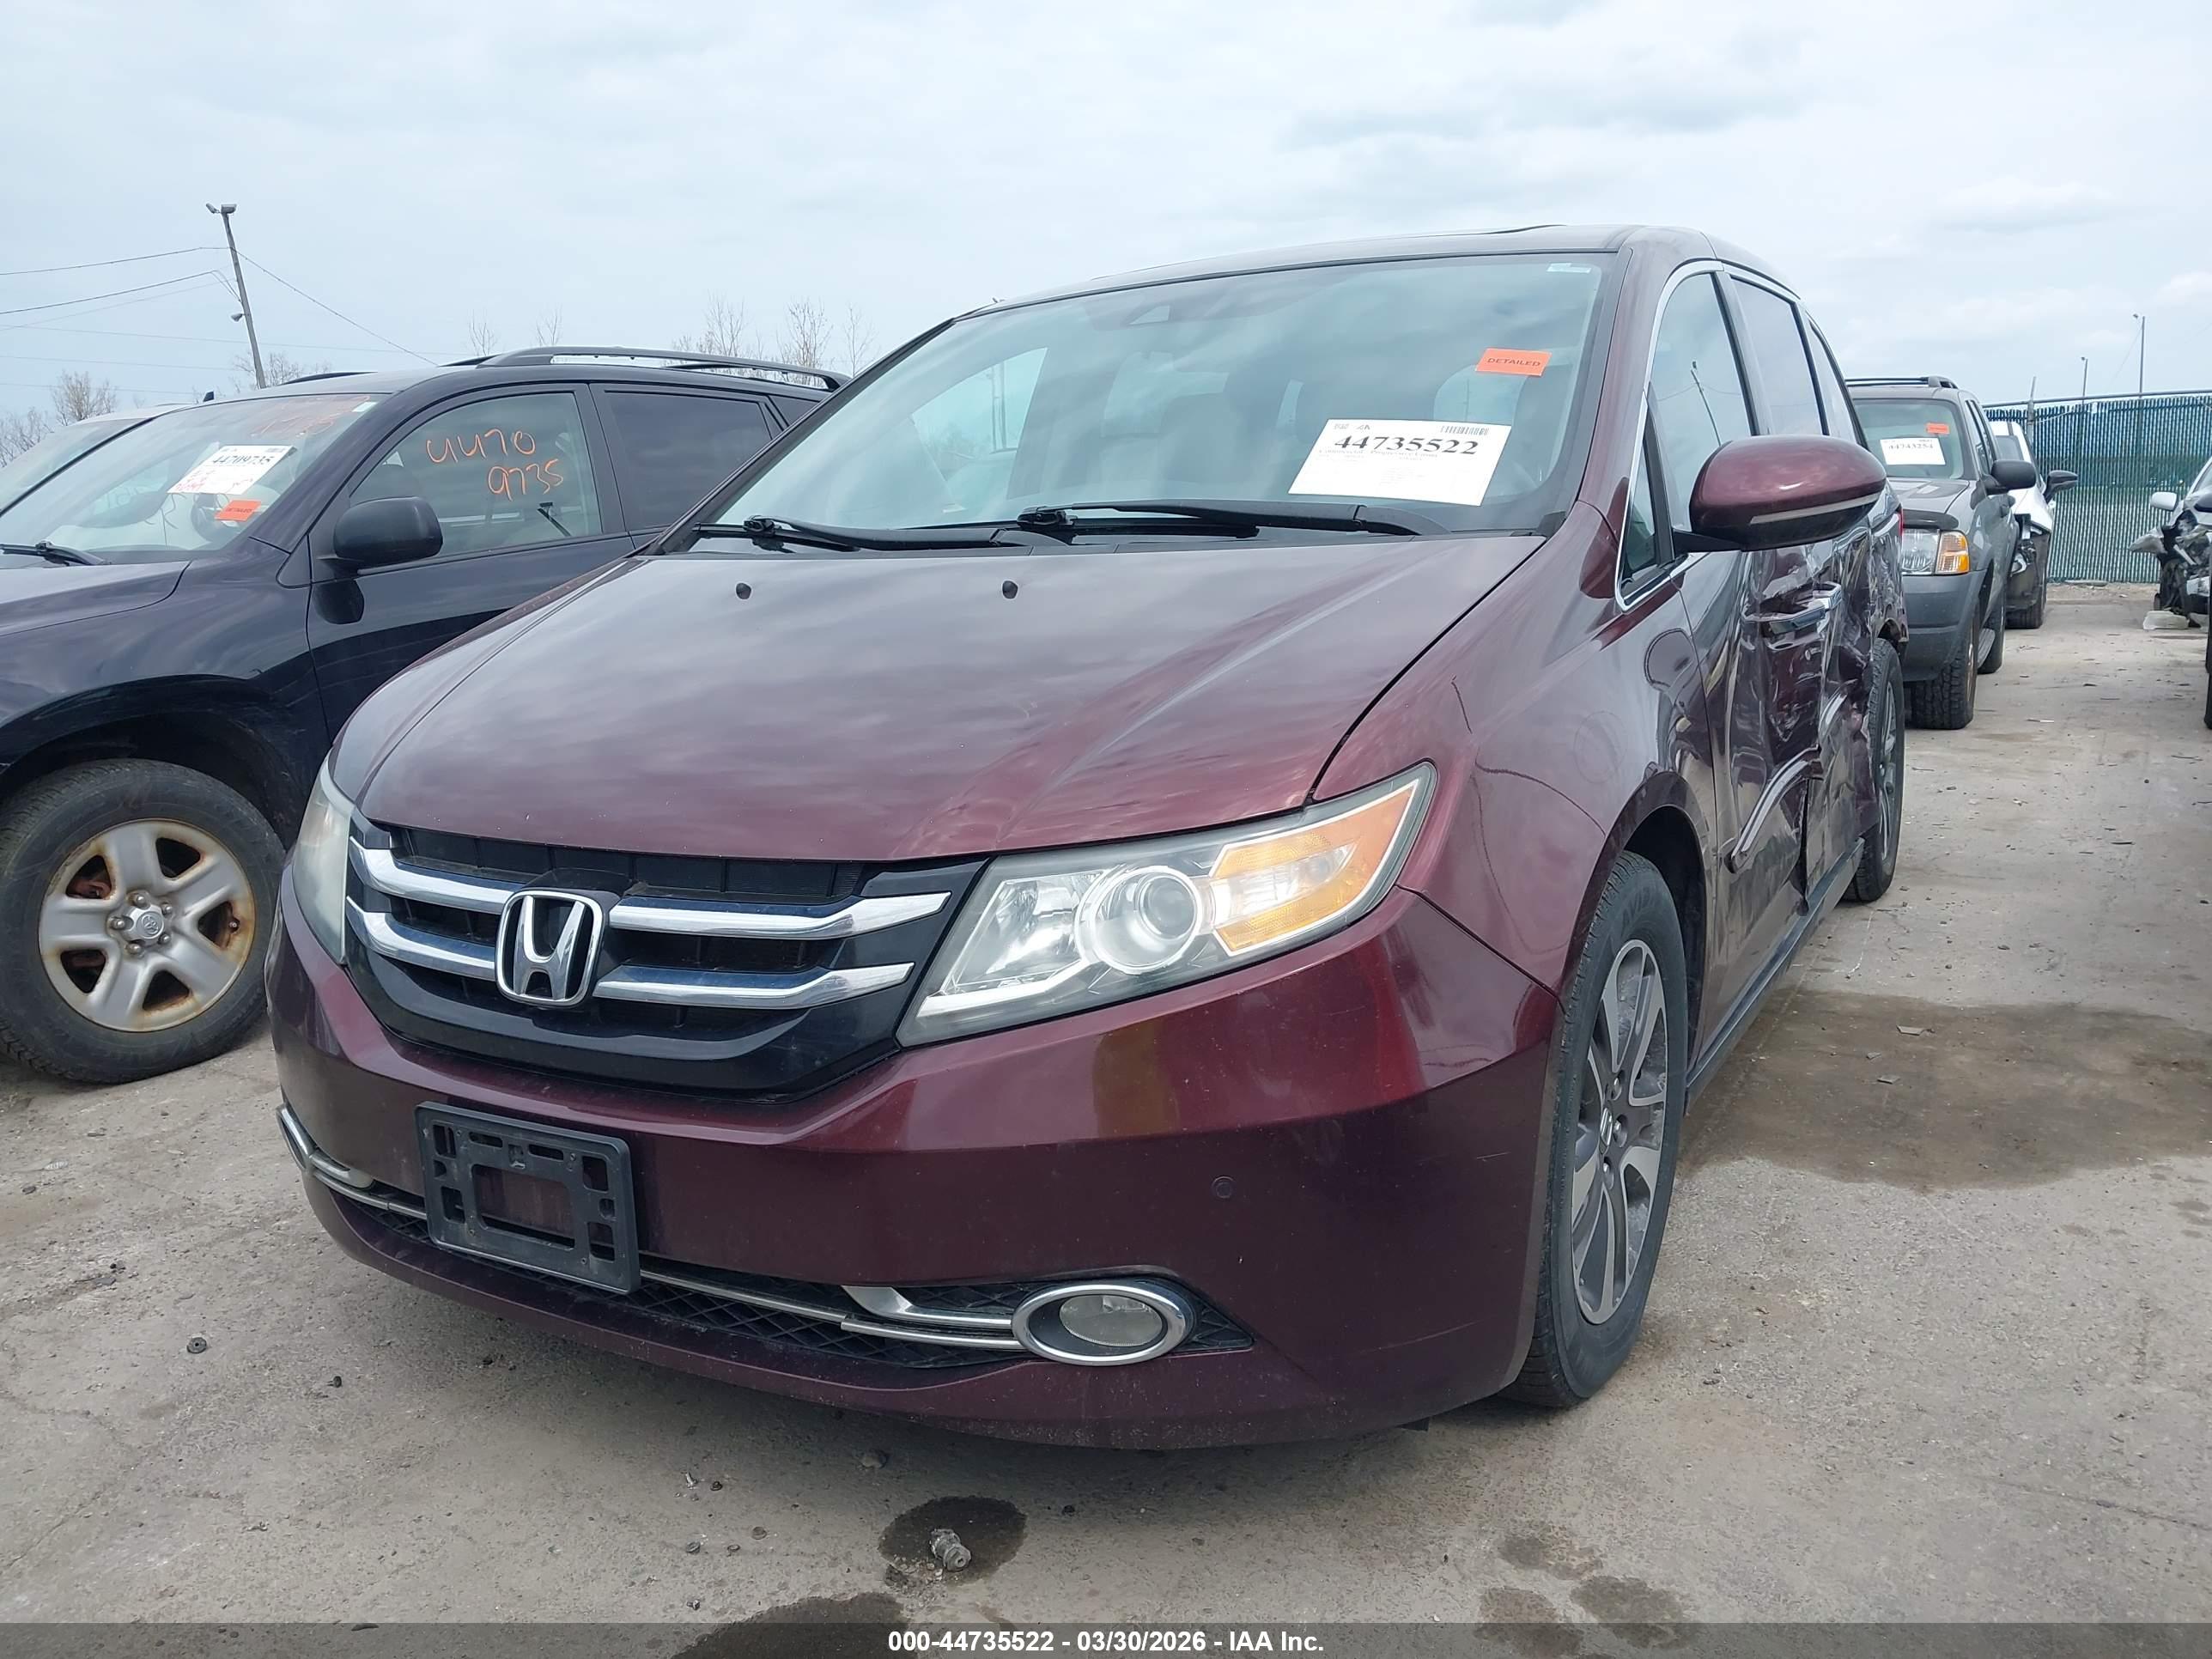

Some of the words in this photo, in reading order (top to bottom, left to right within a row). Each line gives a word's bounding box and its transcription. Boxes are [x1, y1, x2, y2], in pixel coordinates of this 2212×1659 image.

[1486, 357, 1541, 367] DETAILED
[1334, 435, 1480, 455] 44735522
[212, 454, 276, 465] 44709735
[488, 458, 564, 502] 9735
